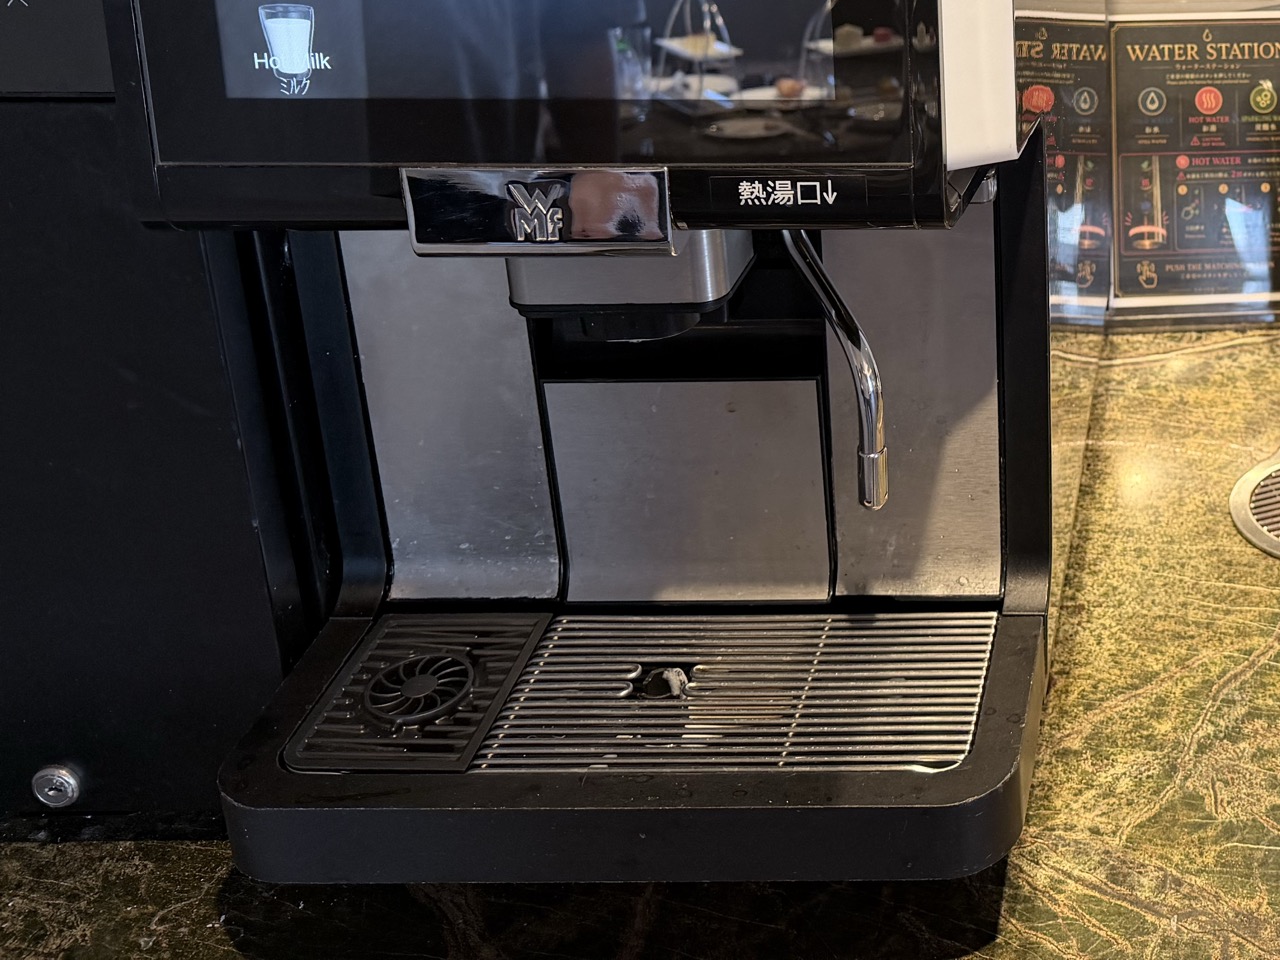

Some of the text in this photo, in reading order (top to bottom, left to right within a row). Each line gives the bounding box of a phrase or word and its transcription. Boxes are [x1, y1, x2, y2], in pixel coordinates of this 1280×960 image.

[253, 52, 332, 70] Ho ilk
[1126, 43, 1200, 62] WATER
[280, 77, 311, 96] ミルク
[1191, 157, 1210, 166] HOT
[1212, 156, 1241, 165] WATER
[738, 180, 821, 206] 熱湯口
